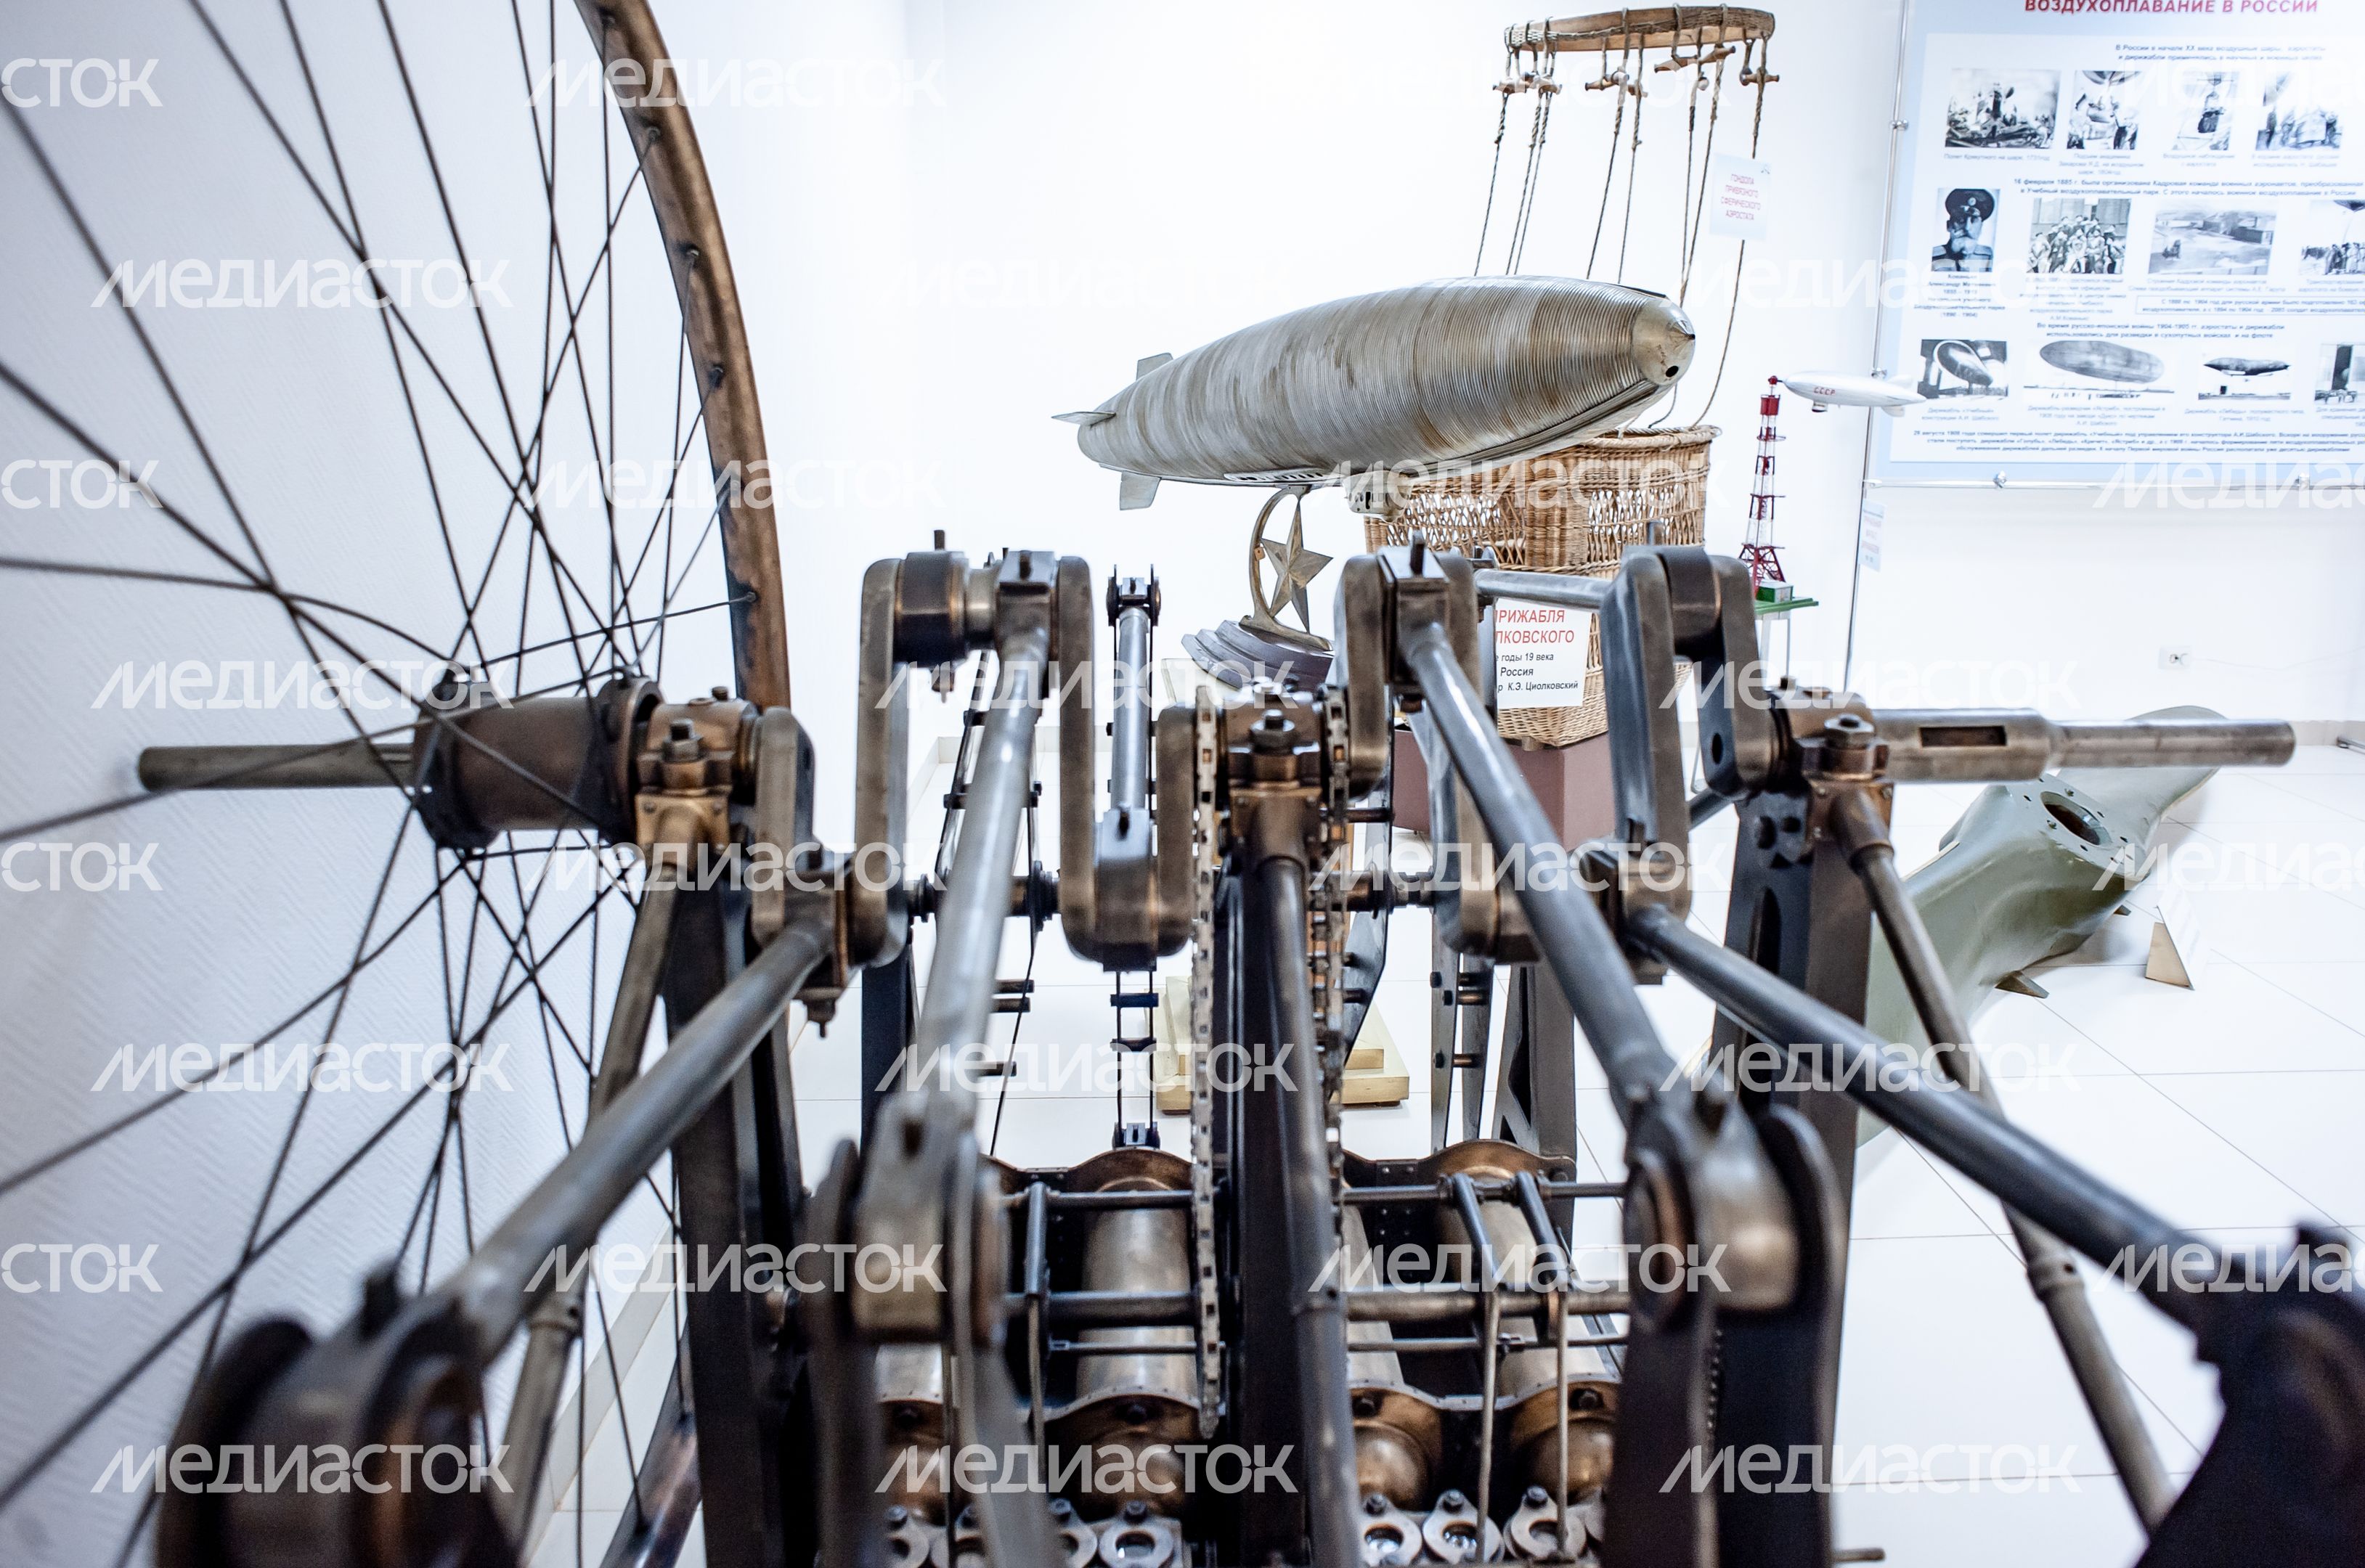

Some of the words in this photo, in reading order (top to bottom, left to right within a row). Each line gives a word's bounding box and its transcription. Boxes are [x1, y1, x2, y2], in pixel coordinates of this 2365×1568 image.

[2024, 0, 2215, 14] ВОЗДУХОПЛАВАНИЕ
[2222, 0, 2234, 12] В
[2240, 0, 2318, 12] РОССИИ
[1721, 197, 1761, 211] СФЕРИЧЕСКОГО
[1725, 209, 1754, 220] АЭРОСТАТА
[1814, 387, 1836, 396] СССР
[1526, 653, 1534, 661] 19
[1500, 666, 1534, 677] Россия
[1507, 682, 1523, 691] К.Э.
[1526, 680, 1579, 692] Циолковский
